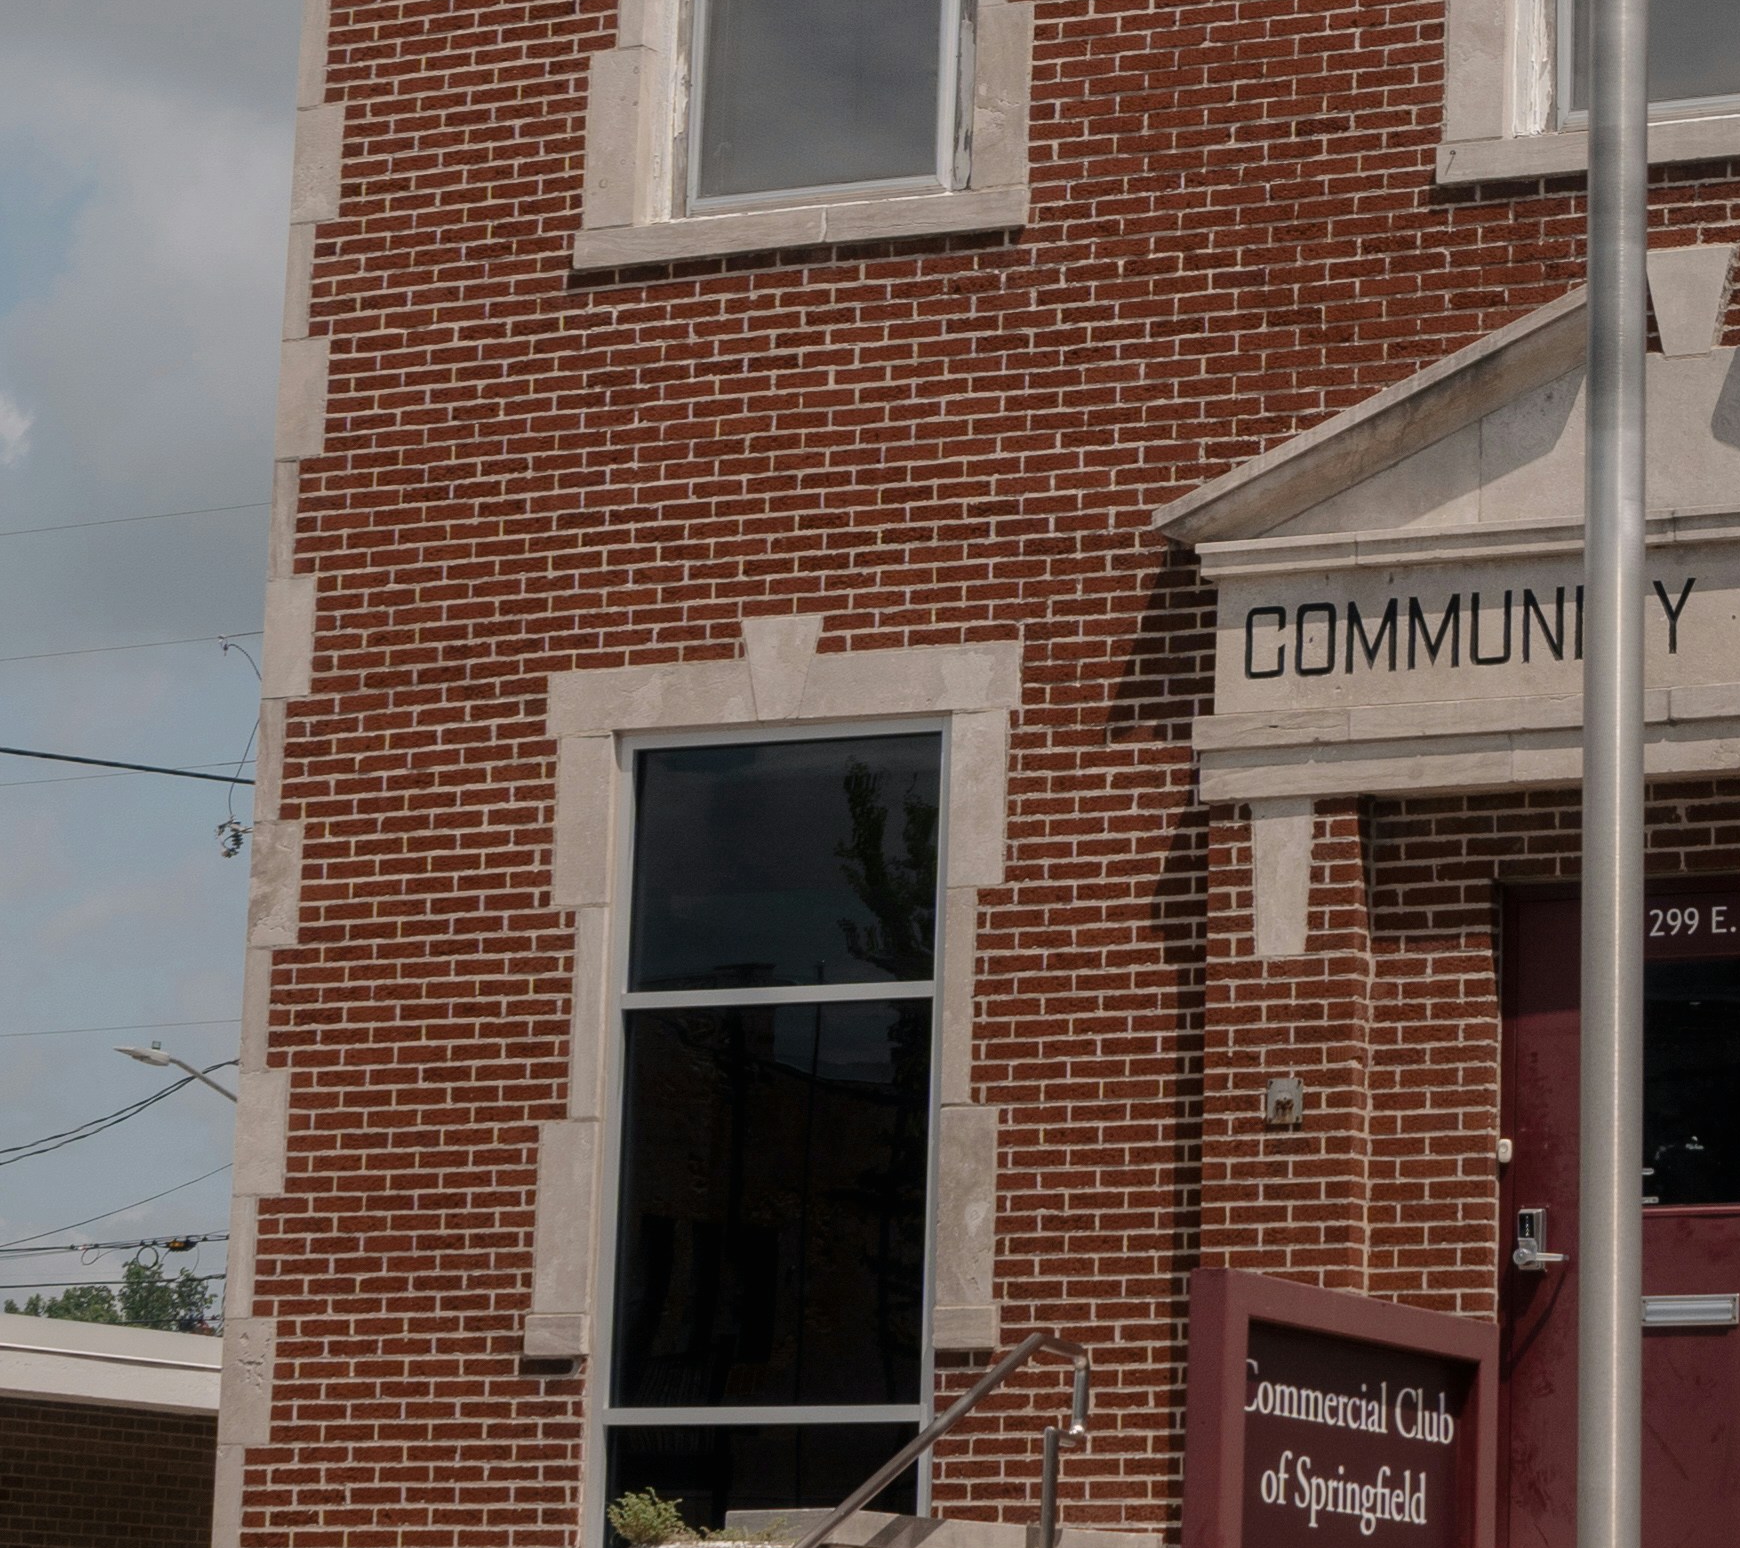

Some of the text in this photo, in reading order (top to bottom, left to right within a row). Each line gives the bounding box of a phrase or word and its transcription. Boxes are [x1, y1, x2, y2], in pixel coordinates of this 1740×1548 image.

[1244, 577, 1697, 680] COMMUNIY
[1649, 906, 1737, 936] 299 E.
[1395, 1387, 1454, 1444] Club
[1261, 1450, 1427, 1535] of Springfield
